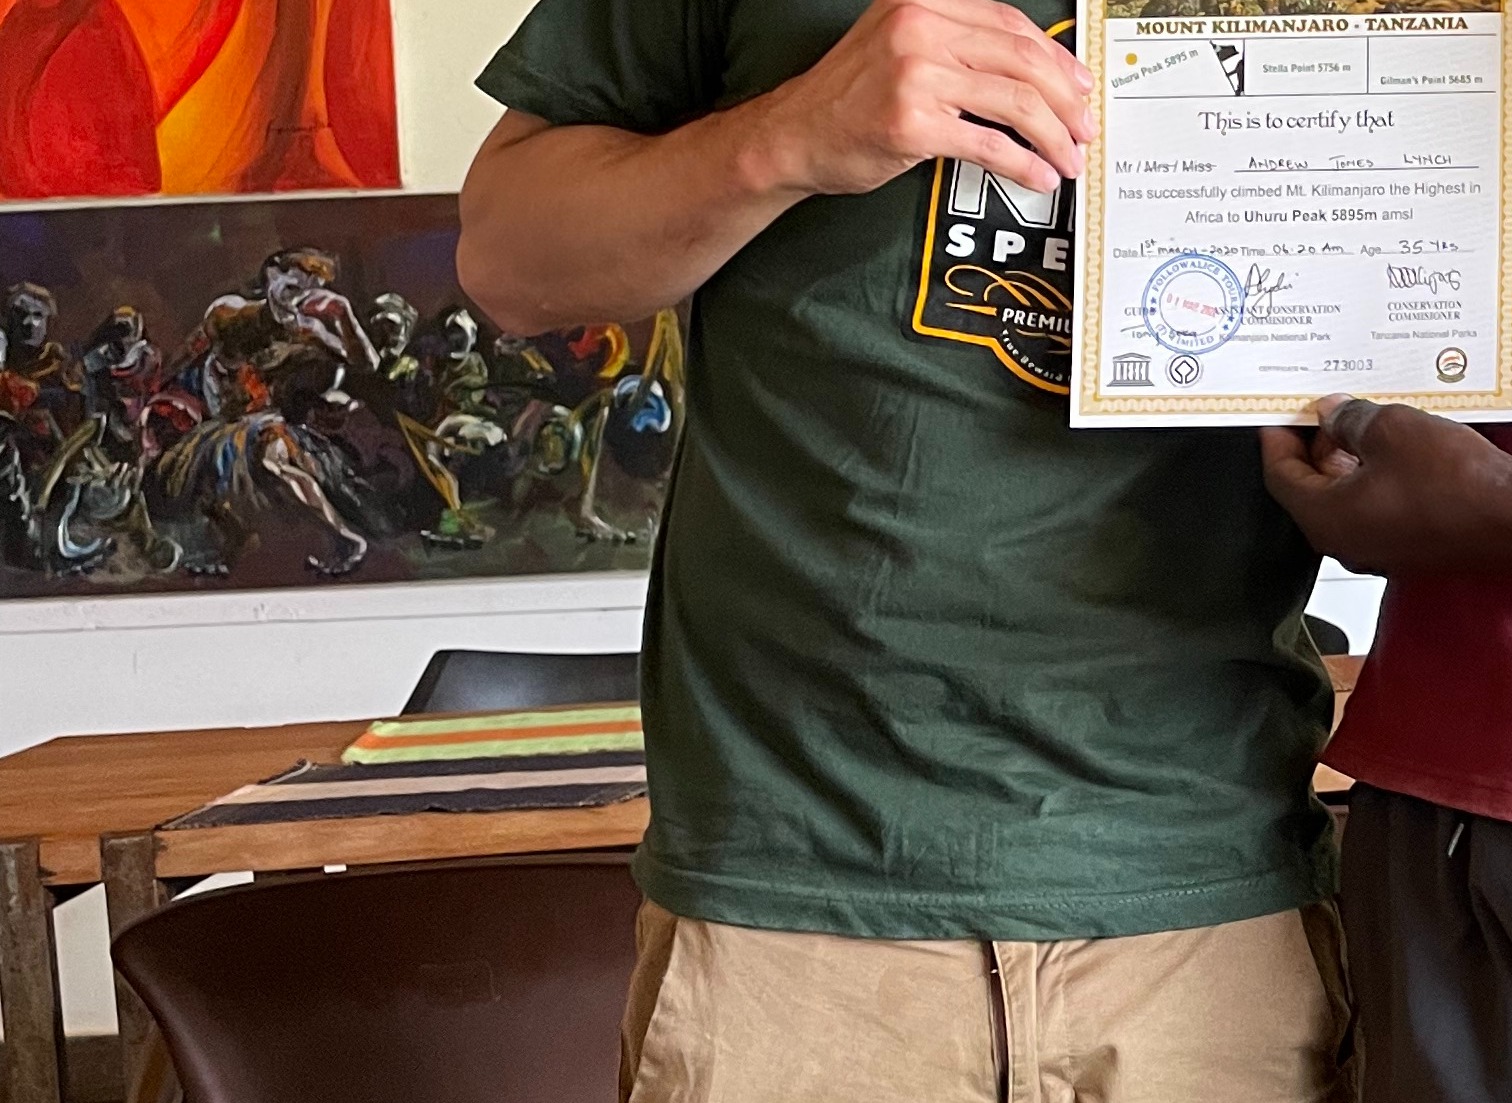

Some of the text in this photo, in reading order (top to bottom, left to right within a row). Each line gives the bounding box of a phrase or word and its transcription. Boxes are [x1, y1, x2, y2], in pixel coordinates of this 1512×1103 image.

[1136, 21, 1207, 35] MOUNT
[1212, 18, 1349, 34] KILIMANJARO
[1365, 16, 1469, 32] TANZANIA
[1110, 48, 1199, 89] Uhuru Peak 5895 m
[1262, 62, 1351, 74] Stella Point 5756 m
[1380, 74, 1483, 85] Gilman's Point 5685 m
[1198, 109, 1395, 136] This is to certify that
[1115, 161, 1132, 173] Mr
[1144, 160, 1170, 173] Mrs
[1182, 159, 1214, 172] Miss
[1249, 156, 1308, 170] ANDREW
[1403, 153, 1452, 166] LYNCH
[1118, 186, 1143, 200] has
[1146, 185, 1228, 201] successfully
[1230, 184, 1283, 198] climbed
[1311, 183, 1386, 199] Kilimanjaro
[1389, 183, 1411, 196] the
[1414, 182, 1466, 198] Highest
[1469, 181, 1482, 194] in
[1184, 208, 1414, 224] Africa to Uhuru Peak 5895m amsl
[945, 222, 1069, 271] SPE
[1241, 246, 1265, 257] Time
[1360, 245, 1382, 258] Age
[1399, 239, 1423, 255] 35
[1267, 304, 1341, 315] CONSERVATION
[1387, 300, 1462, 311] CONSERVATION
[1219, 332, 1331, 343] Kmanjaro National Park
[1371, 329, 1478, 340] Tanzania National Parks
[1323, 359, 1373, 371] 273003
